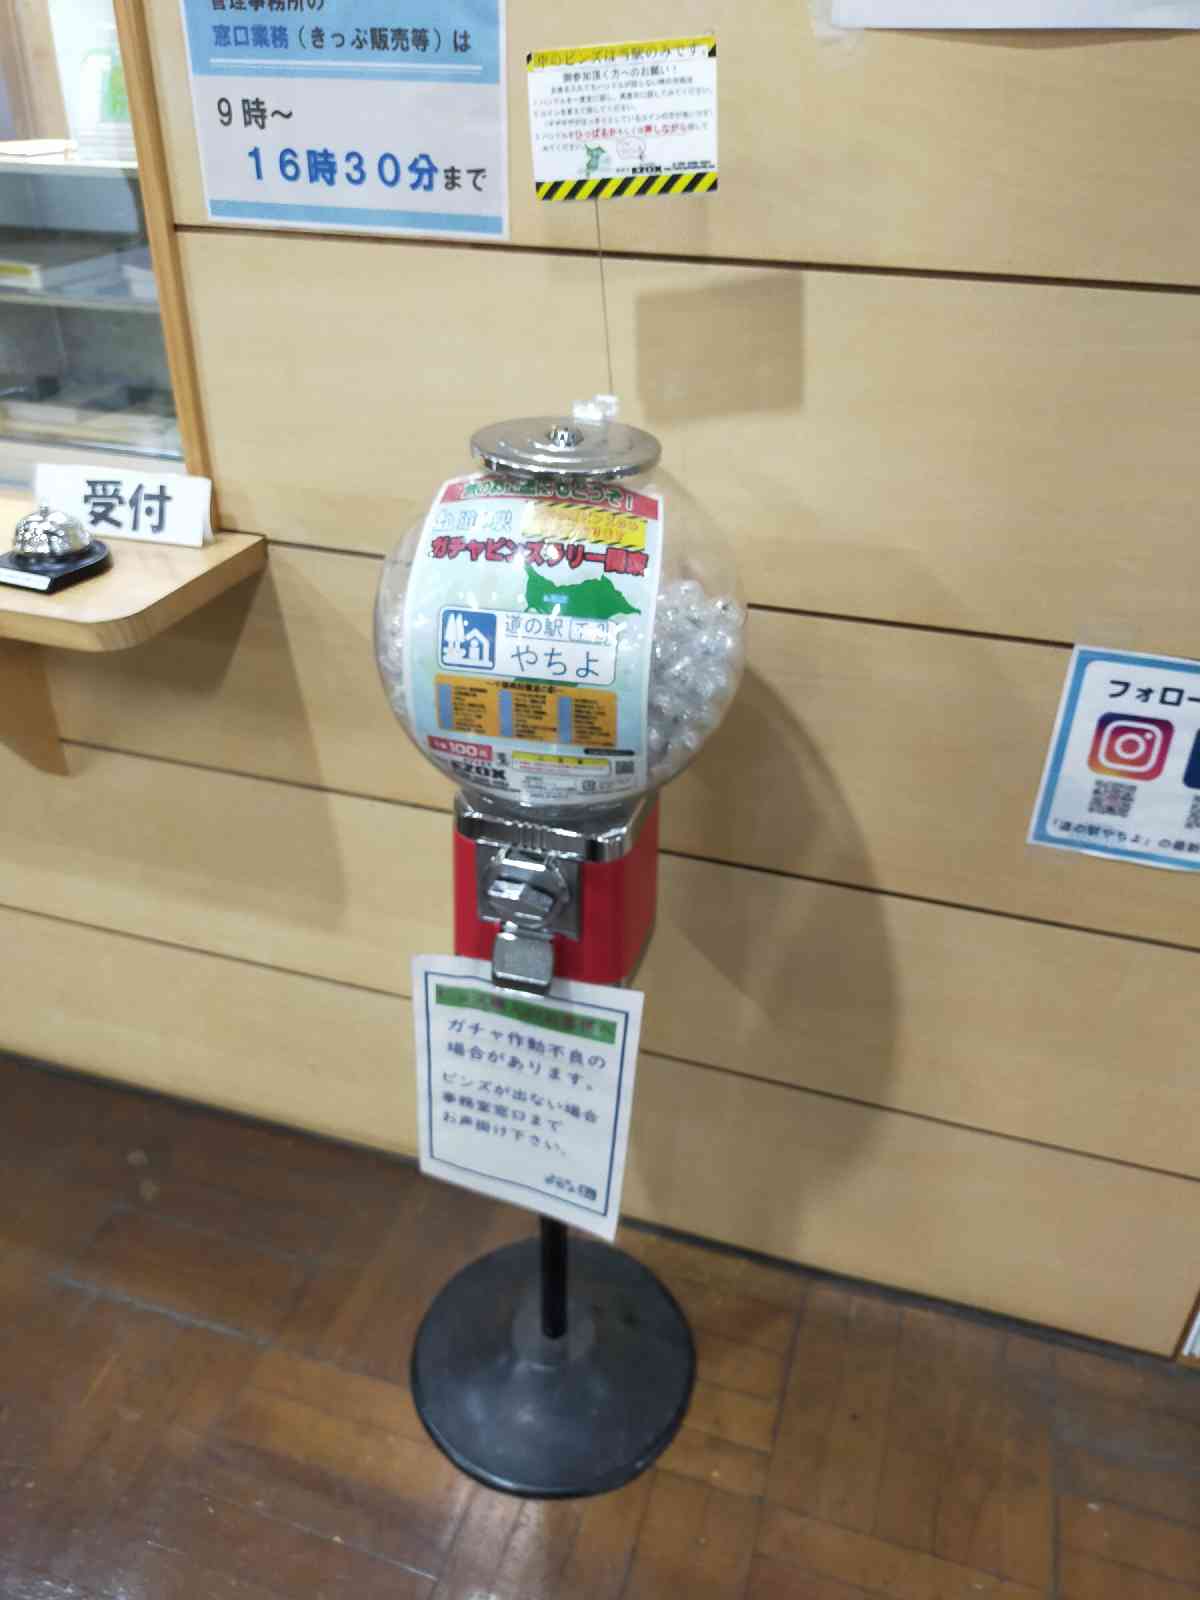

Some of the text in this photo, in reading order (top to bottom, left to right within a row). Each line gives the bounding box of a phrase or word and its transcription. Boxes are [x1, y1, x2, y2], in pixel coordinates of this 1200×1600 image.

[247, 145, 489, 193] 16時30分まで
[83, 479, 173, 534] 受付
[510, 644, 600, 679] やちよ
